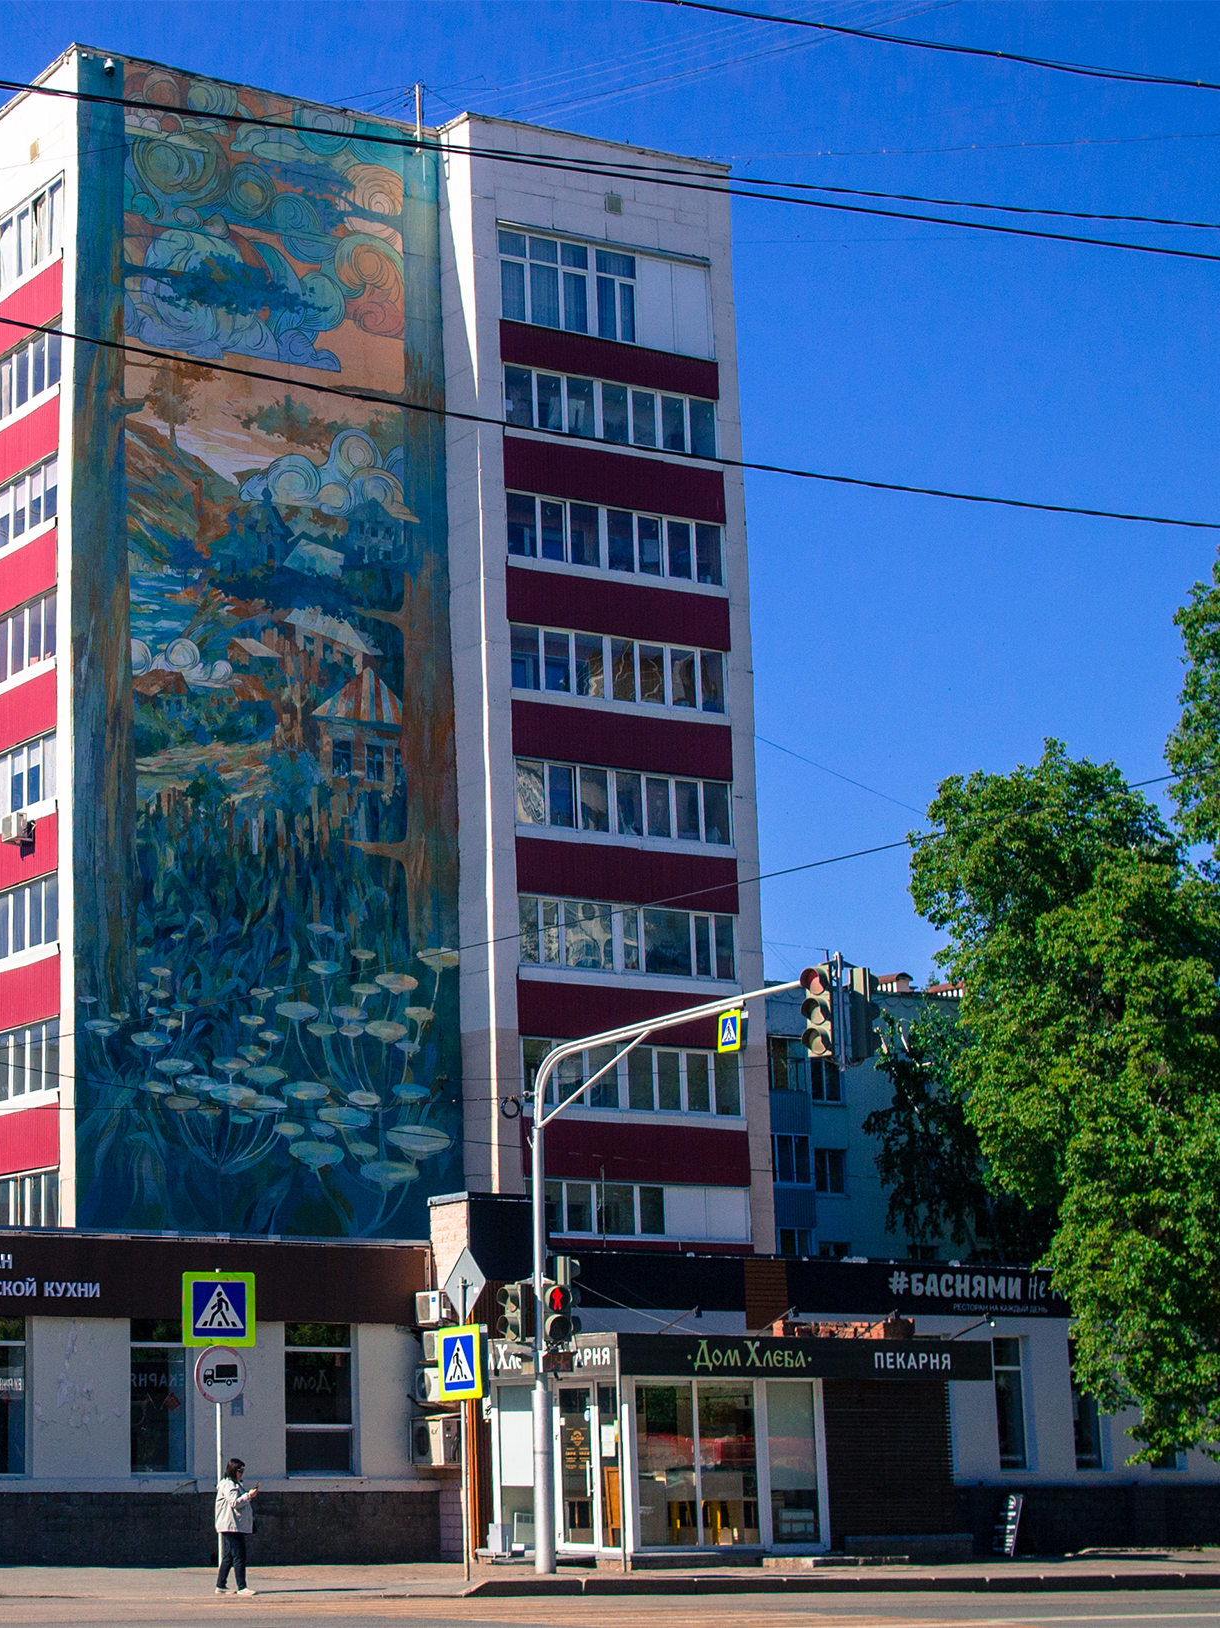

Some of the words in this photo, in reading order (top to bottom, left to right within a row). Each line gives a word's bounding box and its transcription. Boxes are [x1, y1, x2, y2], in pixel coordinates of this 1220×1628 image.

[43, 1281, 101, 1298] КУХНИ
[888, 1270, 1022, 1300] #БАСНЯМИ
[1028, 1275, 1046, 1301] Не
[953, 1303, 988, 1312] РЕСТОРАН
[989, 1304, 999, 1312] НА
[1000, 1304, 1029, 1315] КАЖДЫЙ
[1030, 1305, 1048, 1315] ДЕНЬ
[874, 1351, 951, 1370] ПЕКАРНЯ
